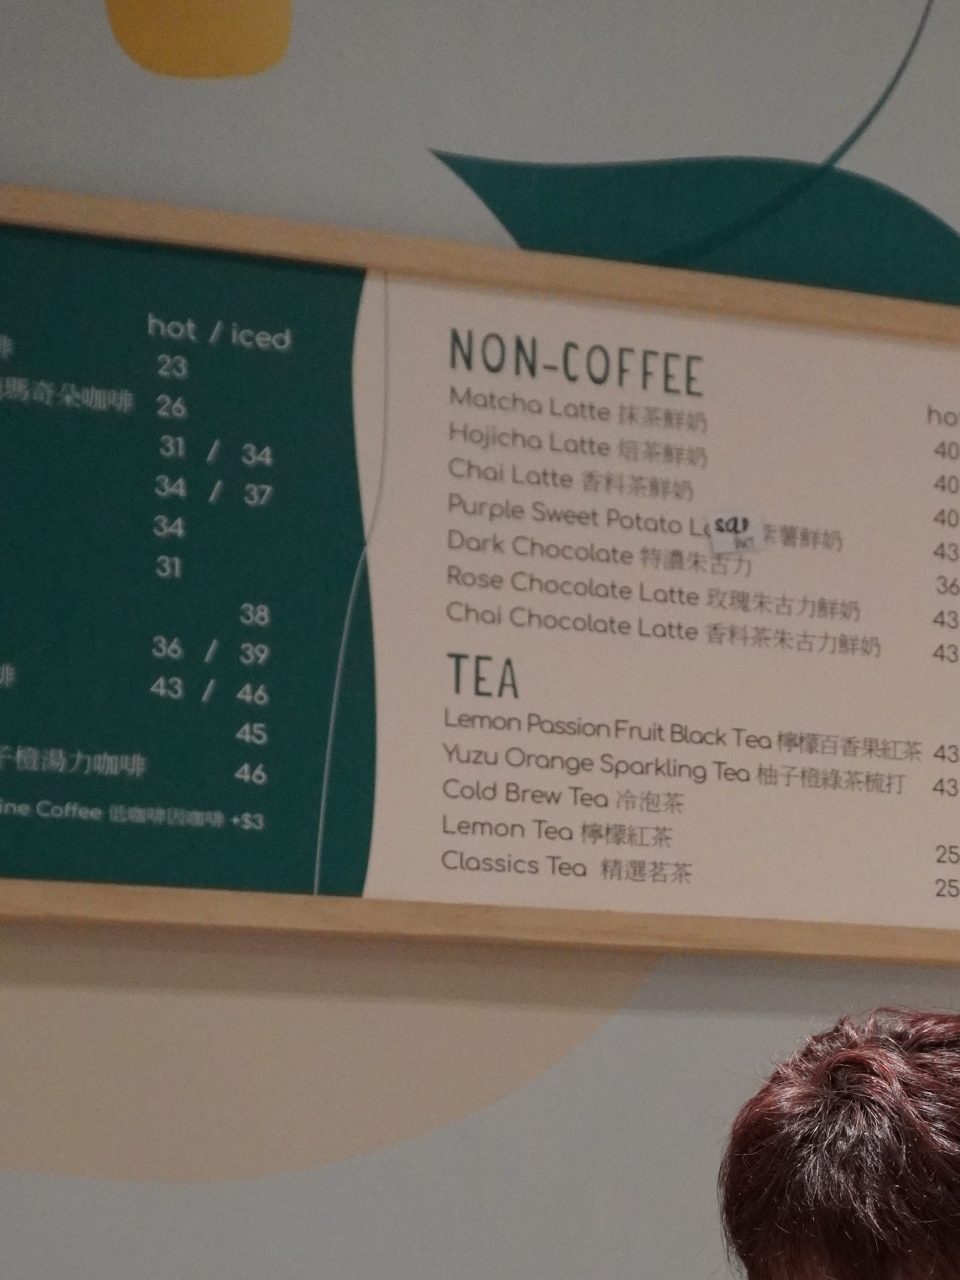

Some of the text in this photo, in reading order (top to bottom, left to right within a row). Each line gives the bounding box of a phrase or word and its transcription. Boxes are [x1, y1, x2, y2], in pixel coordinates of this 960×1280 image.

[148, 313, 196, 341] hot
[232, 323, 292, 351] iced
[158, 354, 188, 378] 23
[450, 328, 702, 400] NON-COFFEE
[157, 394, 187, 418] 26
[450, 386, 543, 415] Matcha
[550, 397, 611, 422] Latte
[160, 435, 185, 457] 31
[242, 444, 272, 466] 34
[449, 422, 543, 450] Hojicha
[549, 433, 611, 457] Latte
[934, 441, 960, 460] 40
[448, 457, 504, 482] Chai
[512, 465, 573, 489] Latte
[934, 475, 959, 494] 40
[155, 475, 186, 497] 34
[244, 484, 273, 506] 37
[154, 515, 184, 537] 34
[448, 493, 525, 522] Purple
[532, 501, 598, 526] Sweet
[607, 508, 683, 534] Potato
[933, 509, 959, 528] 40
[448, 529, 504, 554] Dark
[512, 535, 634, 565] Chocolate
[933, 542, 959, 562] 43
[156, 555, 181, 577] 31
[447, 565, 504, 590] Rose
[510, 571, 632, 600] Chocolate
[639, 582, 700, 606] Latte
[936, 575, 960, 596] 36
[240, 603, 270, 626] 38
[446, 601, 502, 624] Chai
[509, 606, 631, 635] Chocolate
[638, 618, 698, 641] Latte
[933, 610, 959, 629] 43
[152, 636, 183, 659] 36
[240, 643, 269, 665] 39
[932, 644, 959, 663] 43
[447, 653, 518, 699] TEA
[150, 677, 183, 699] 43
[236, 683, 269, 705] 46
[236, 723, 267, 745] 45
[444, 708, 522, 731] Lemon
[527, 713, 611, 737] Passion
[615, 719, 665, 742] Fruit
[670, 723, 726, 745] Black
[732, 728, 772, 749] Tea
[442, 743, 498, 766] Yuzu
[505, 747, 594, 776] Orange
[600, 753, 707, 784] Sparkling
[713, 761, 750, 782] Tea
[933, 744, 959, 763] 43
[235, 763, 267, 784] 46
[442, 778, 497, 801] Cold
[505, 782, 562, 804] Brew
[568, 786, 609, 808] Tea
[932, 778, 958, 797] 43
[36, 800, 103, 820] Coffee
[442, 815, 525, 837] Lemon
[533, 819, 573, 841] Tea
[441, 850, 539, 875] Classics
[546, 855, 587, 877] Tea
[936, 845, 960, 864] 25
[935, 878, 960, 898] 25
